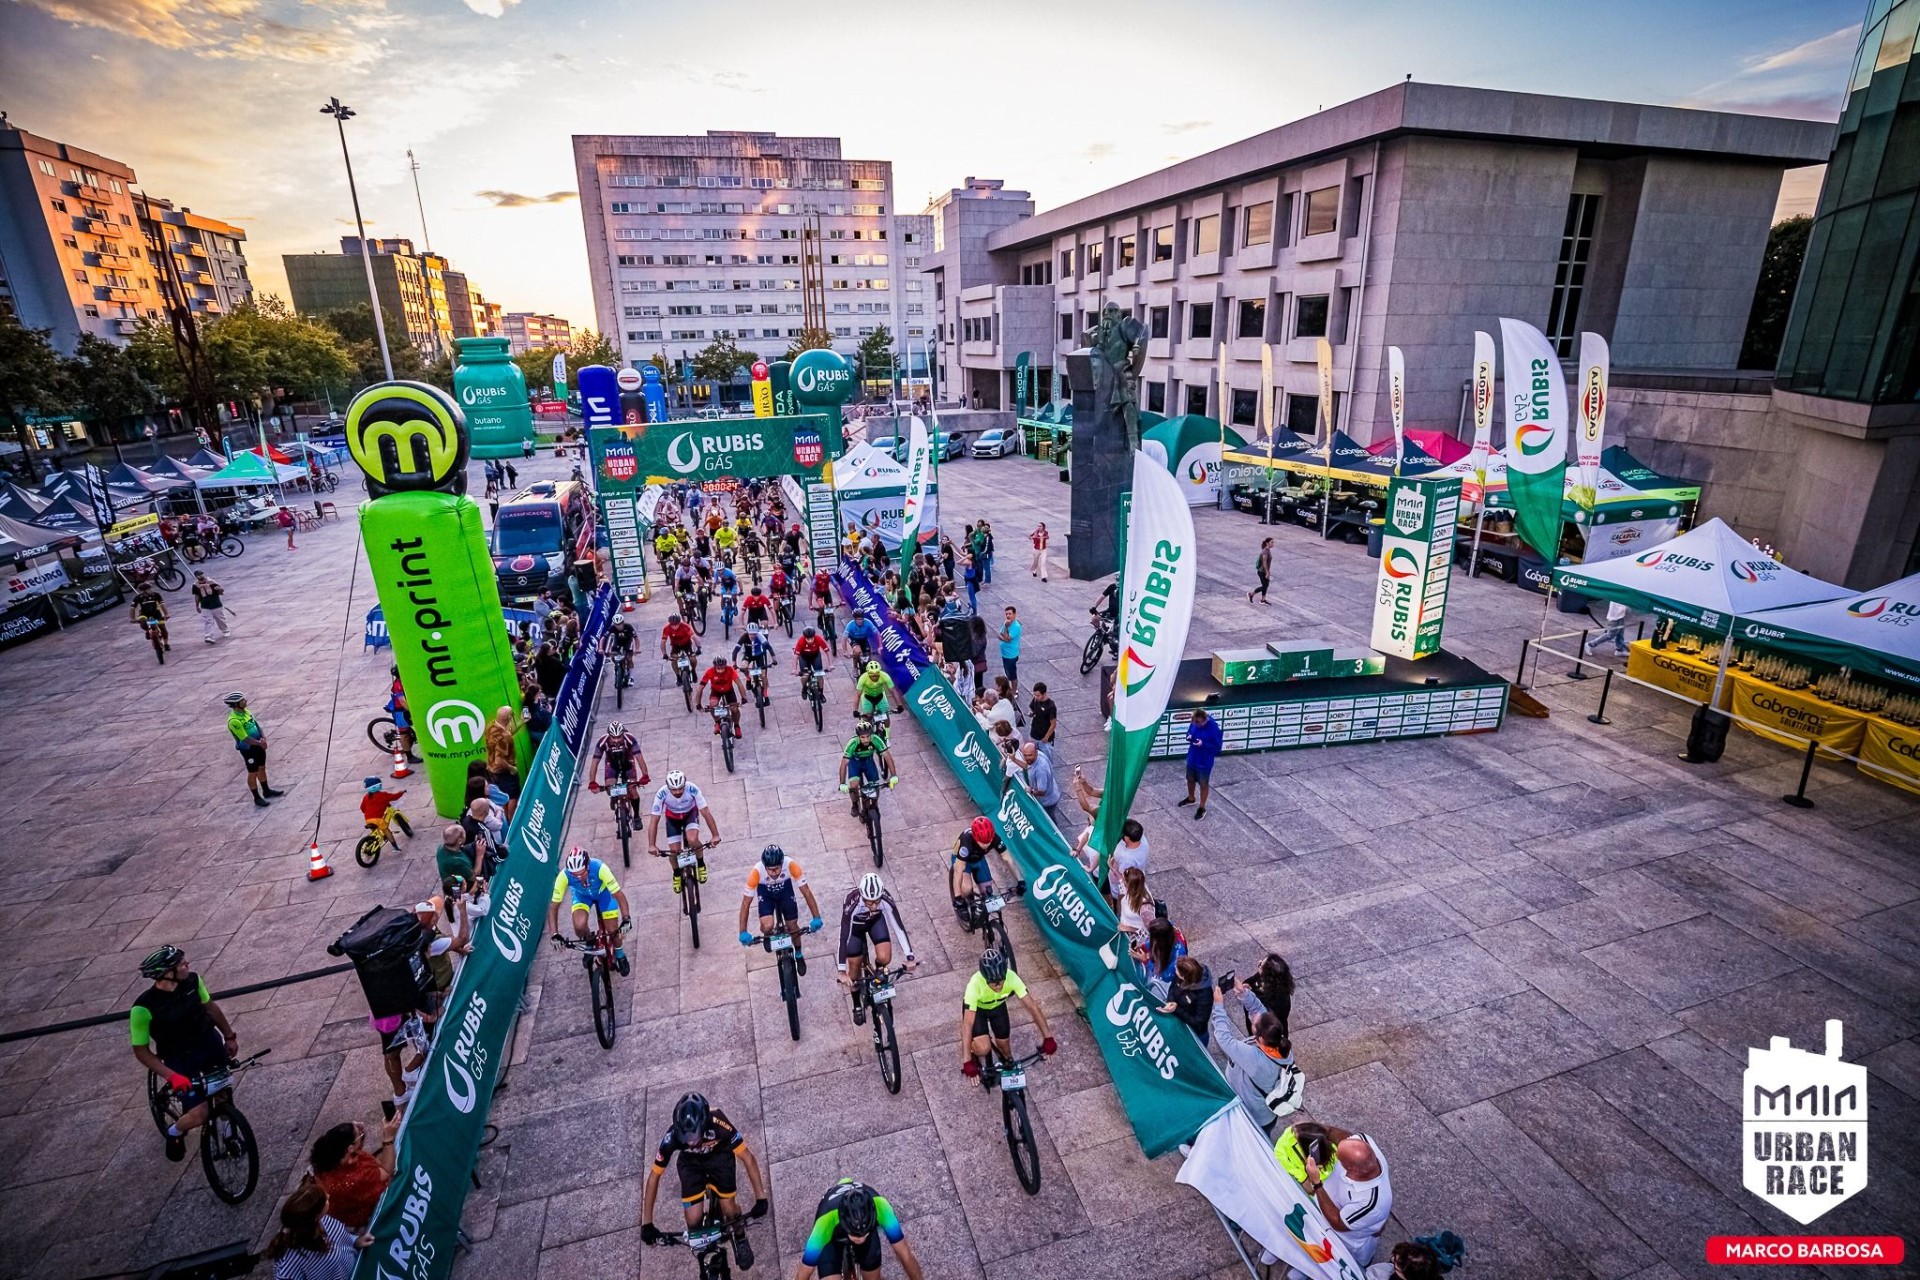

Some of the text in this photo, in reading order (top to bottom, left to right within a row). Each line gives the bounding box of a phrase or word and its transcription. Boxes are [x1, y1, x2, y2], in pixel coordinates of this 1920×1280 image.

[817, 369, 849, 381] RUBiS
[475, 387, 507, 396] RUBiS
[817, 381, 835, 392] GÁS
[477, 396, 492, 405] GÁS
[474, 416, 502, 425] butano
[702, 432, 764, 454] RUBiS
[796, 444, 822, 456] URBAN
[607, 456, 636, 468] URBAN
[704, 454, 734, 471] GÁS
[798, 453, 819, 463] RACE
[612, 466, 634, 477] RACE
[1206, 462, 1222, 472] RU
[1207, 472, 1222, 484] GÁ
[881, 508, 904, 520] RUB
[1395, 508, 1421, 521] URBAN
[881, 520, 898, 529] GÁS
[1397, 518, 1418, 530] RACE
[1664, 553, 1715, 572] RUBiS
[1748, 560, 1781, 572] RUBiS
[1525, 568, 1552, 584] Cabre
[1380, 578, 1394, 608] GÁS
[1391, 582, 1412, 642] RUBiS
[1877, 613, 1914, 627] GÁS
[1759, 627, 1785, 639] RUBiS
[1303, 655, 1310, 670] 1
[1354, 658, 1364, 673] 3
[1653, 655, 1708, 683] Cabreira
[1247, 665, 1256, 680] 2
[1884, 667, 1920, 683] www.rub
[1678, 674, 1705, 691] SOLUTIONS
[934, 694, 956, 721] RUBiS
[1751, 692, 1820, 726] Cabreira
[1780, 716, 1816, 736] SOLUTIONS
[428, 746, 486, 759] www.mrprin
[972, 740, 991, 775] RUBiS
[962, 757, 979, 773] GÁS
[528, 798, 546, 837] RUBiS
[1010, 799, 1035, 840] RUBiS
[499, 877, 525, 928] RUBiS
[1056, 881, 1096, 937] RUBiS
[1043, 899, 1065, 928] GÁS
[516, 912, 532, 942] GÁS
[454, 990, 488, 1064] RUBiS
[1116, 1029, 1143, 1057] GÁS
[1133, 1005, 1180, 1080] RUBiS
[470, 1041, 488, 1081] GÁS
[389, 1164, 433, 1271] RUBiS
